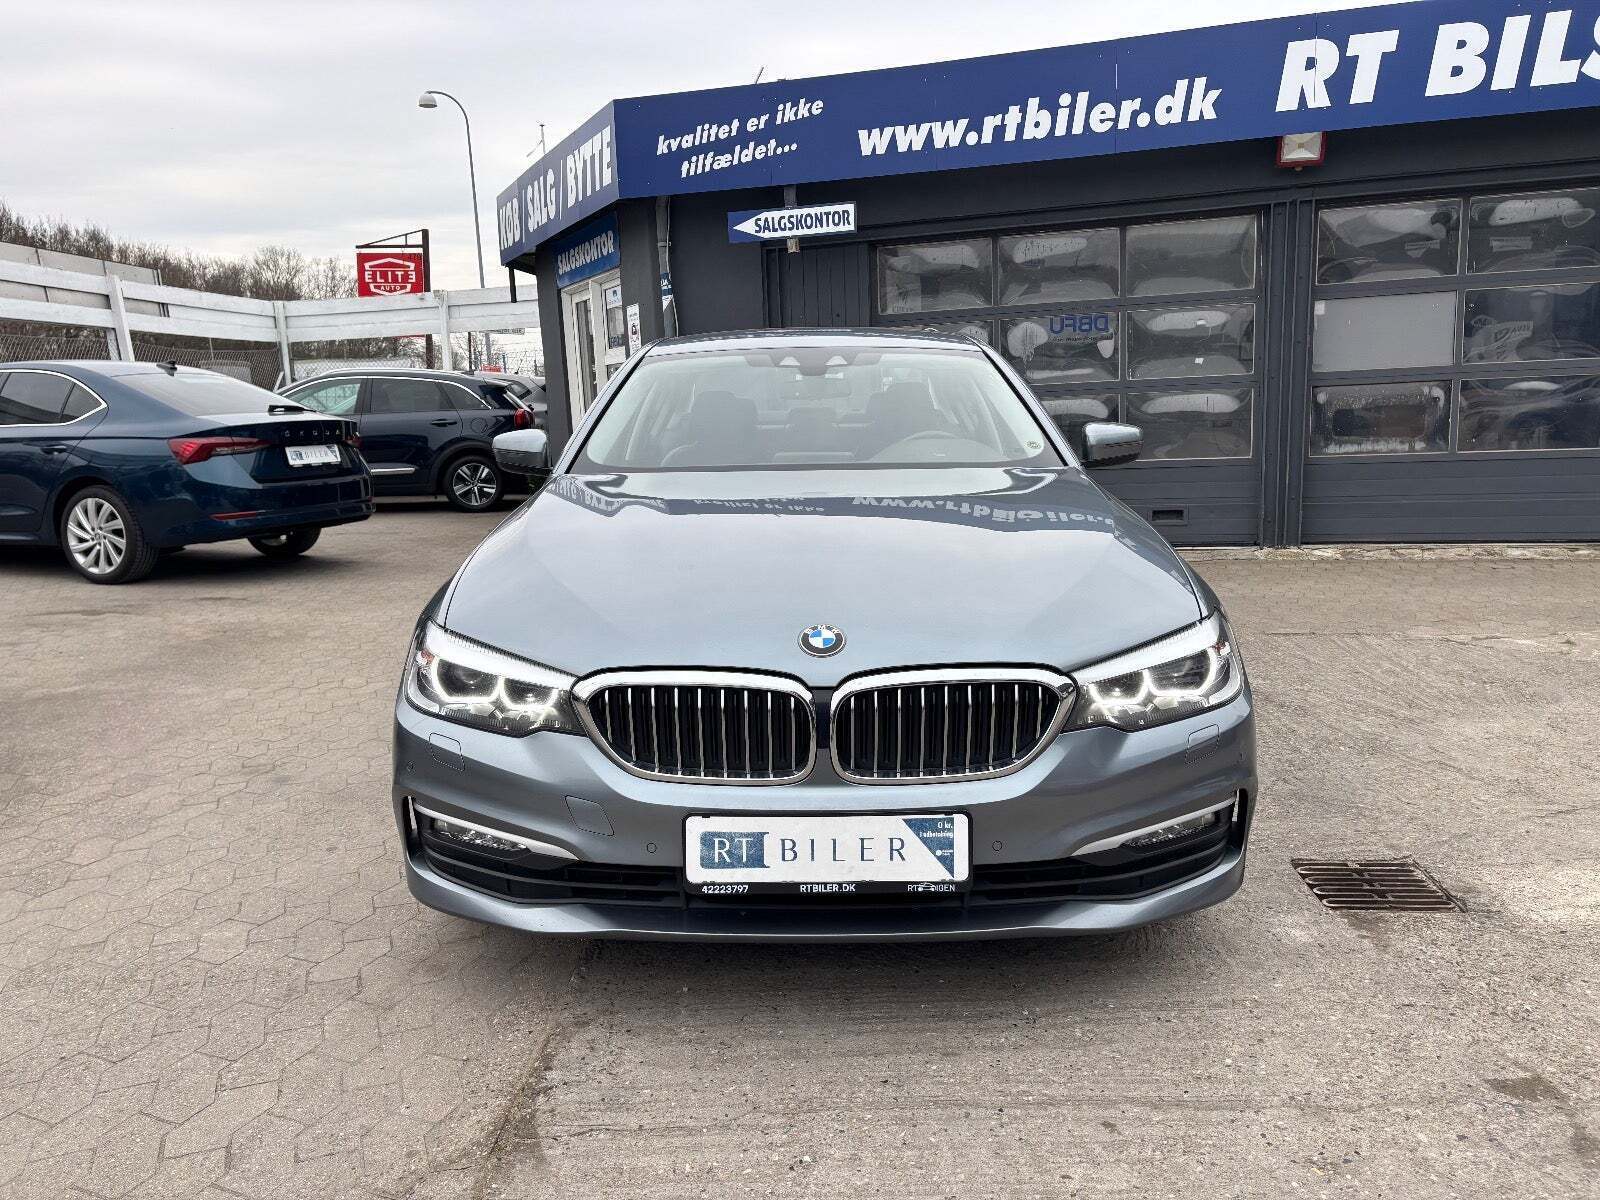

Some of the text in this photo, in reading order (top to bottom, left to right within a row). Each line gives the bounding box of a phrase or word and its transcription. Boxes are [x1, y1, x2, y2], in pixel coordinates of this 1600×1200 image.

[1276, 29, 1400, 112] RT
[656, 97, 825, 156] kvalitet er ikke
[859, 76, 1222, 156] www.rtbiler.dk
[680, 138, 798, 178] tilfældet...
[499, 198, 521, 251] KØB
[526, 168, 556, 233] SALG
[566, 125, 612, 209] BYTTE
[754, 208, 851, 235] SALGSKONTOR
[557, 230, 615, 275] SALGSKONTOR
[364, 270, 416, 283] ELITE
[937, 820, 954, 829] 0 kr.
[713, 836, 907, 864] RT BILER
[701, 884, 749, 894] 42223797
[799, 883, 856, 893] RTBILER.DK
